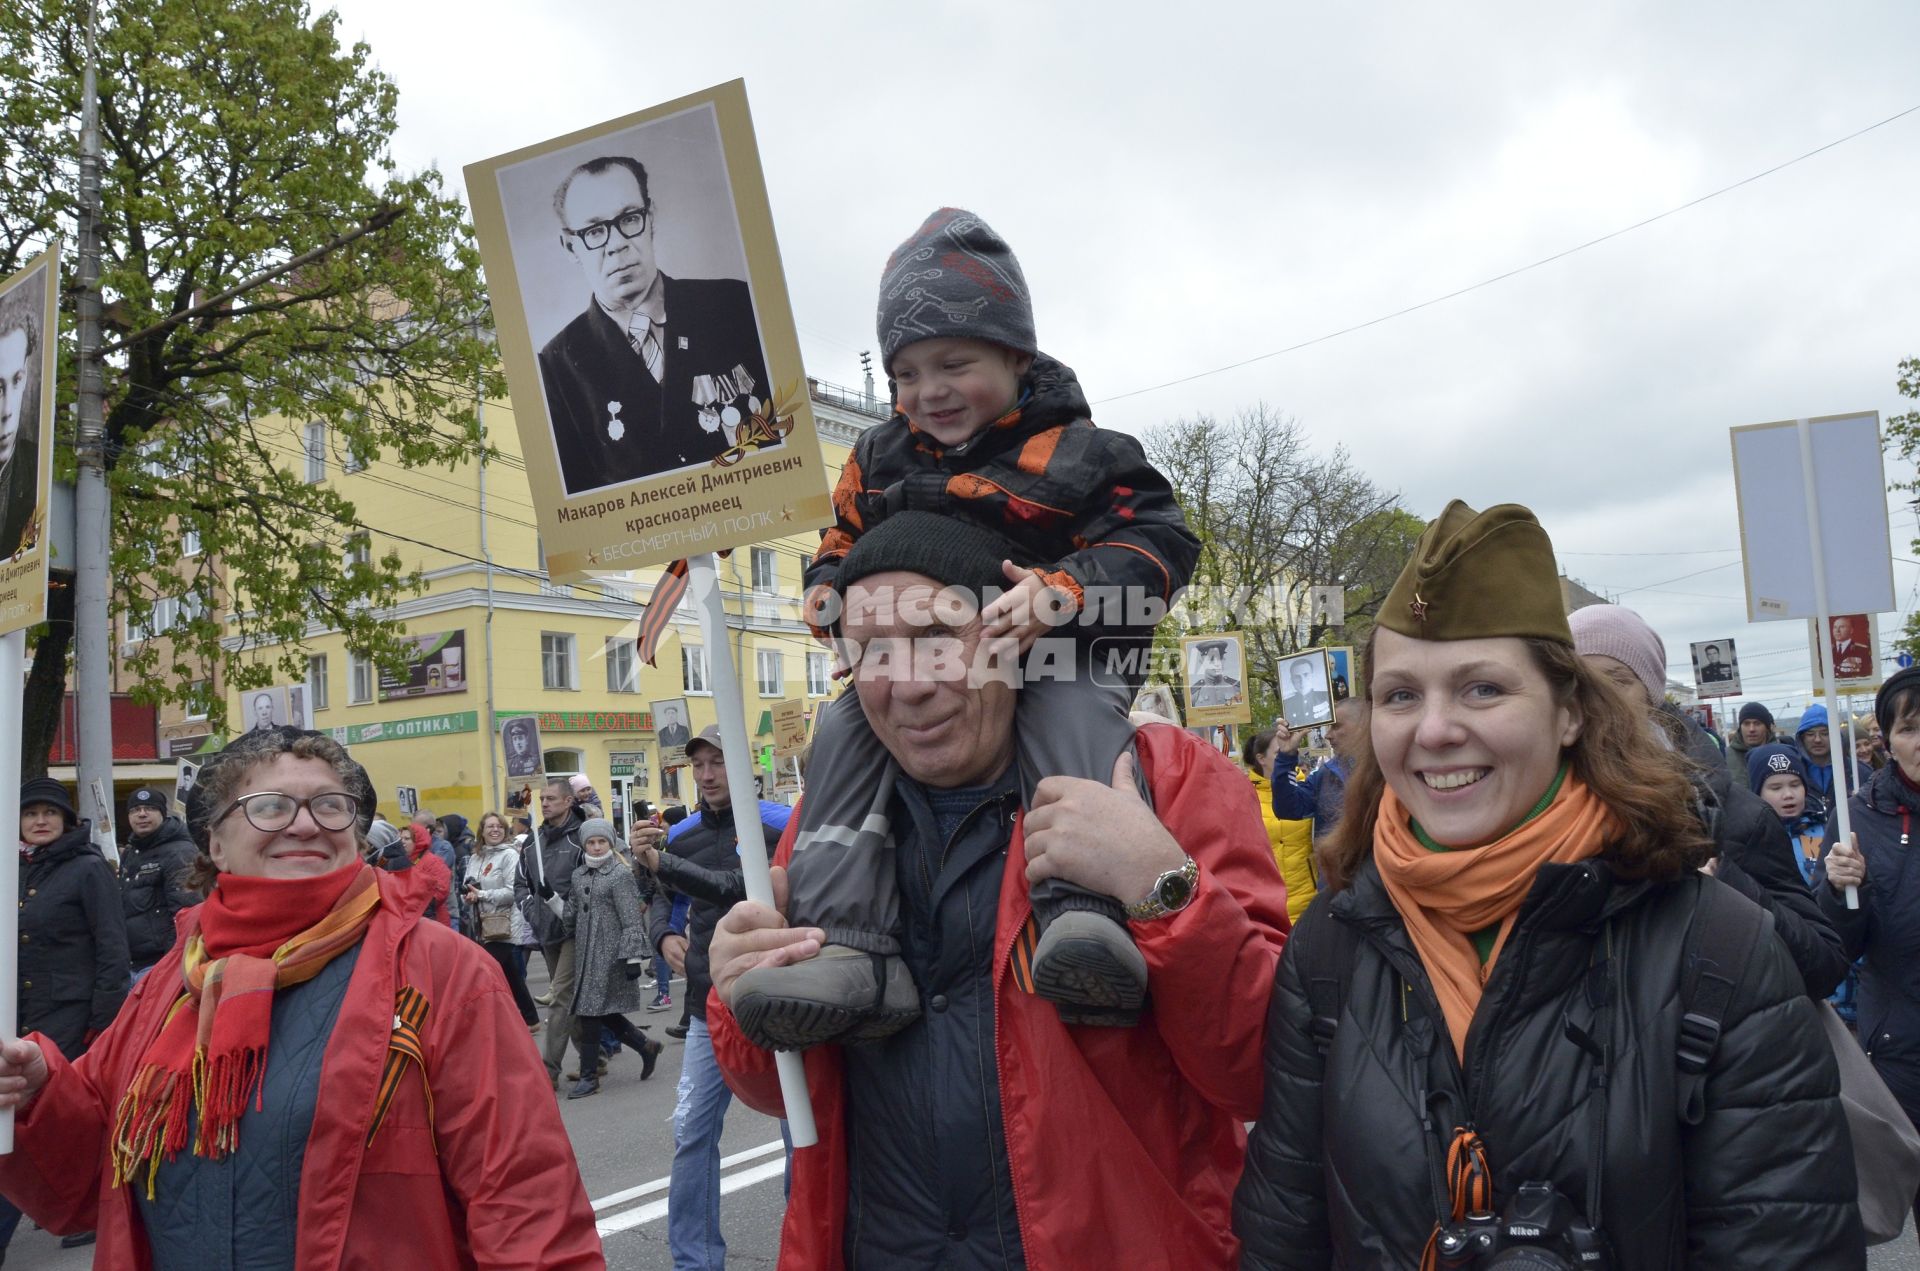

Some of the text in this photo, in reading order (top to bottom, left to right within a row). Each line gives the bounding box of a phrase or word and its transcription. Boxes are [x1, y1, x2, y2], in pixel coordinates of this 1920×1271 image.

[557, 455, 803, 523] Макаров Алексей Дмитриевич
[625, 495, 743, 534] красноармеец
[602, 510, 775, 561] БЕССМЕРТНЫЙ ПОЛК
[6, 559, 41, 584] Дмитриевич
[396, 717, 451, 735] ОПТИКА
[570, 712, 592, 730] НА
[1509, 1226, 1540, 1236] Nikon
